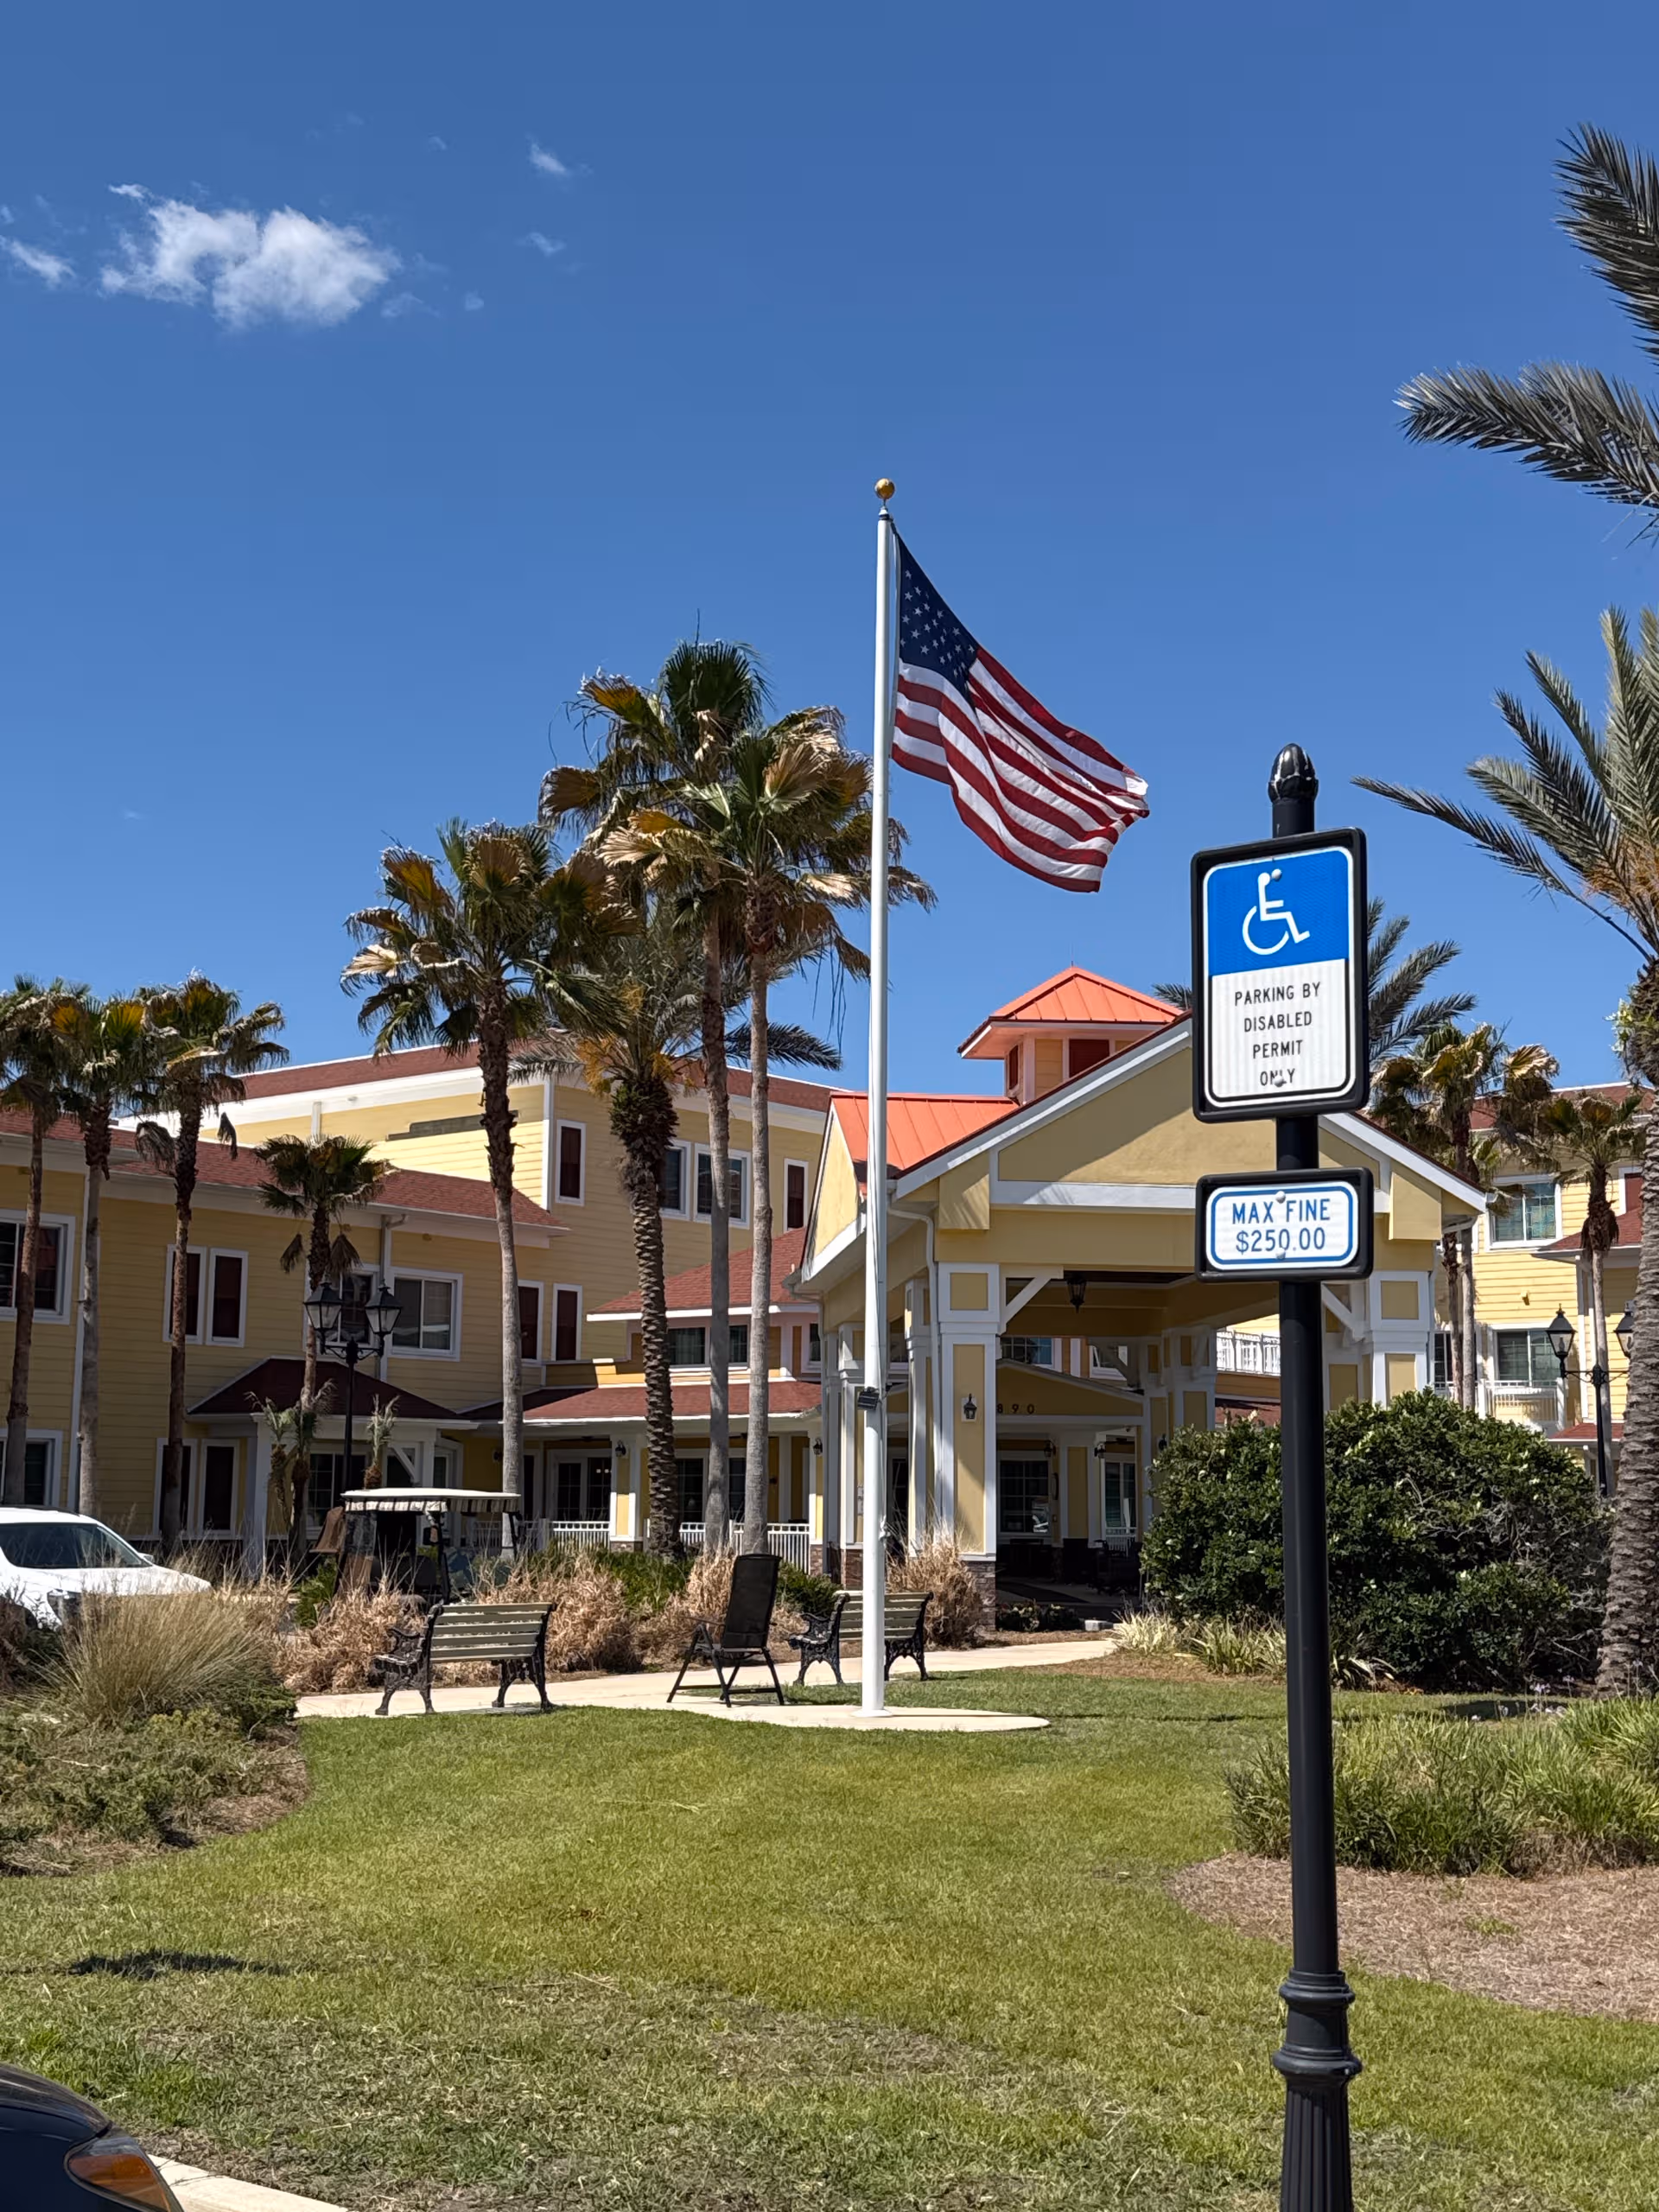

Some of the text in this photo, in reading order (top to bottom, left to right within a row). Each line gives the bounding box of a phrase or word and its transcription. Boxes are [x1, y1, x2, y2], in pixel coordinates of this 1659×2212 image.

[1235, 982, 1321, 1007] PARKING BY
[1243, 1011, 1313, 1033] DISABLED
[1252, 1039, 1303, 1059] PERMIT
[1232, 1198, 1332, 1224] MAX FINE
[1236, 1227, 1325, 1255] $250.00
